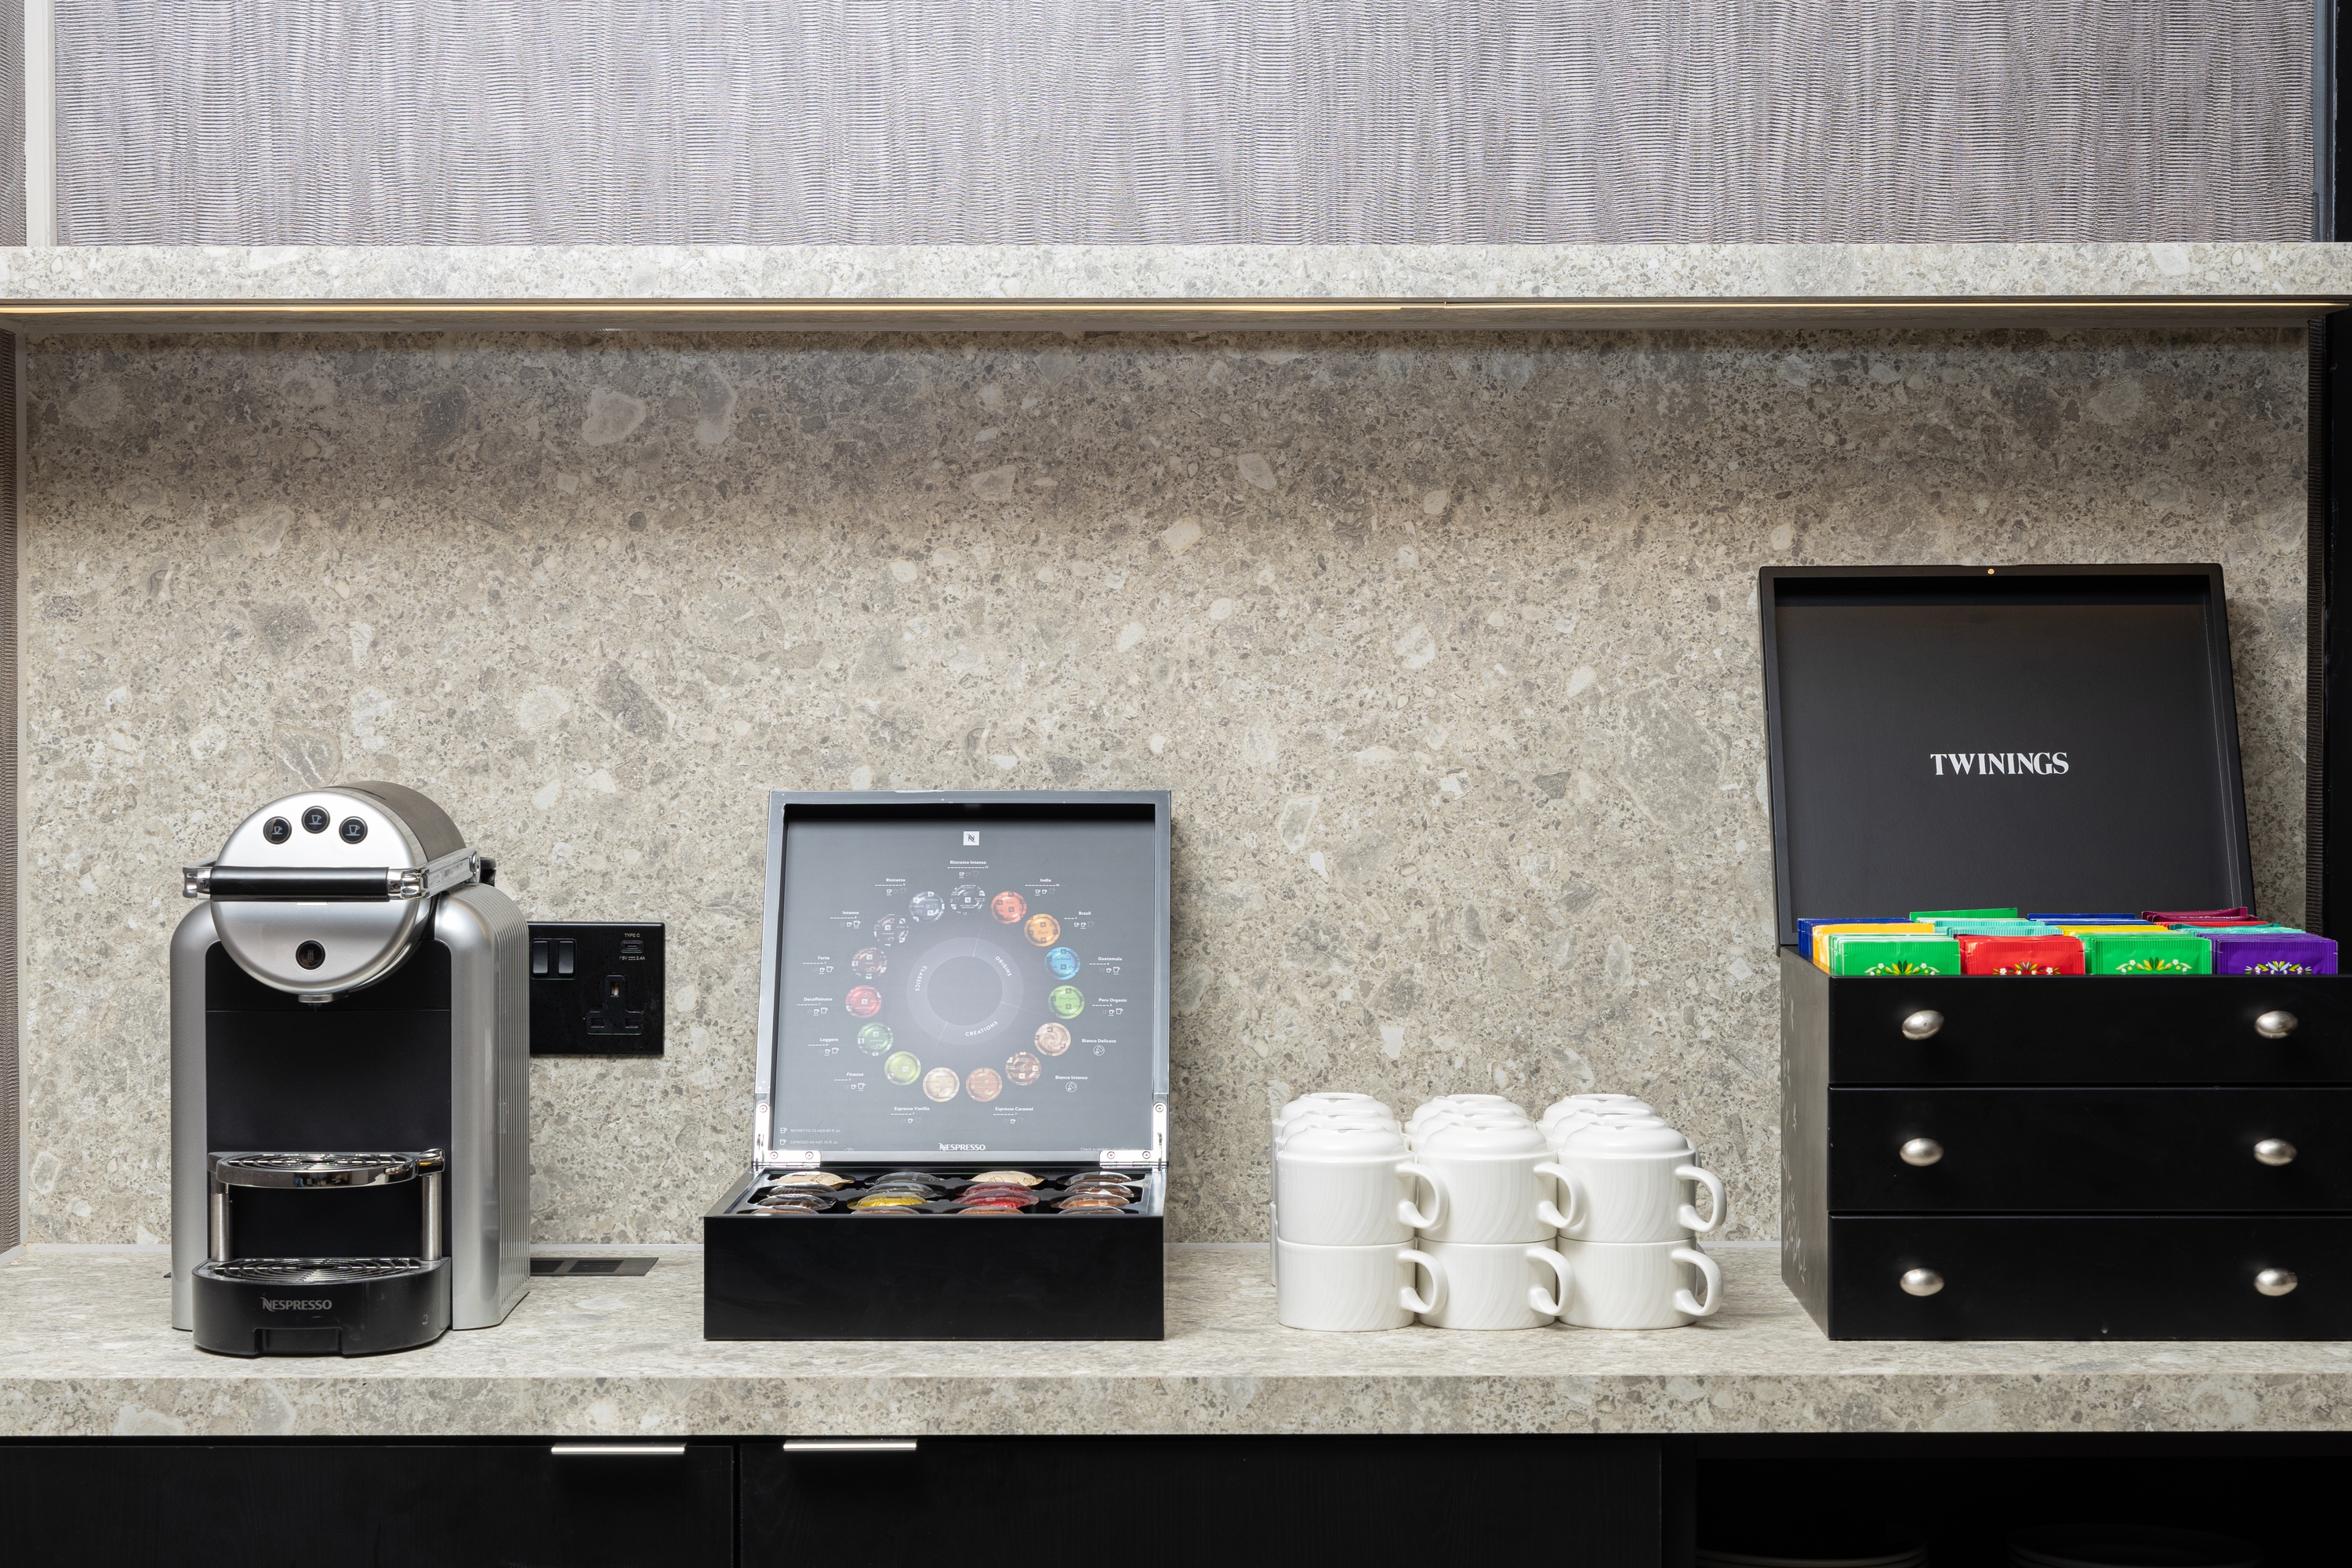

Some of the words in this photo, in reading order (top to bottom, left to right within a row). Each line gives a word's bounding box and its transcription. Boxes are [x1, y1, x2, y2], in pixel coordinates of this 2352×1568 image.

[1930, 752, 2069, 775] TWININGS
[995, 956, 1012, 977] ORIGINS
[914, 965, 927, 992] CLASSICS
[965, 1020, 998, 1036] CREATIONS
[260, 1297, 332, 1312] NESPRESSO
